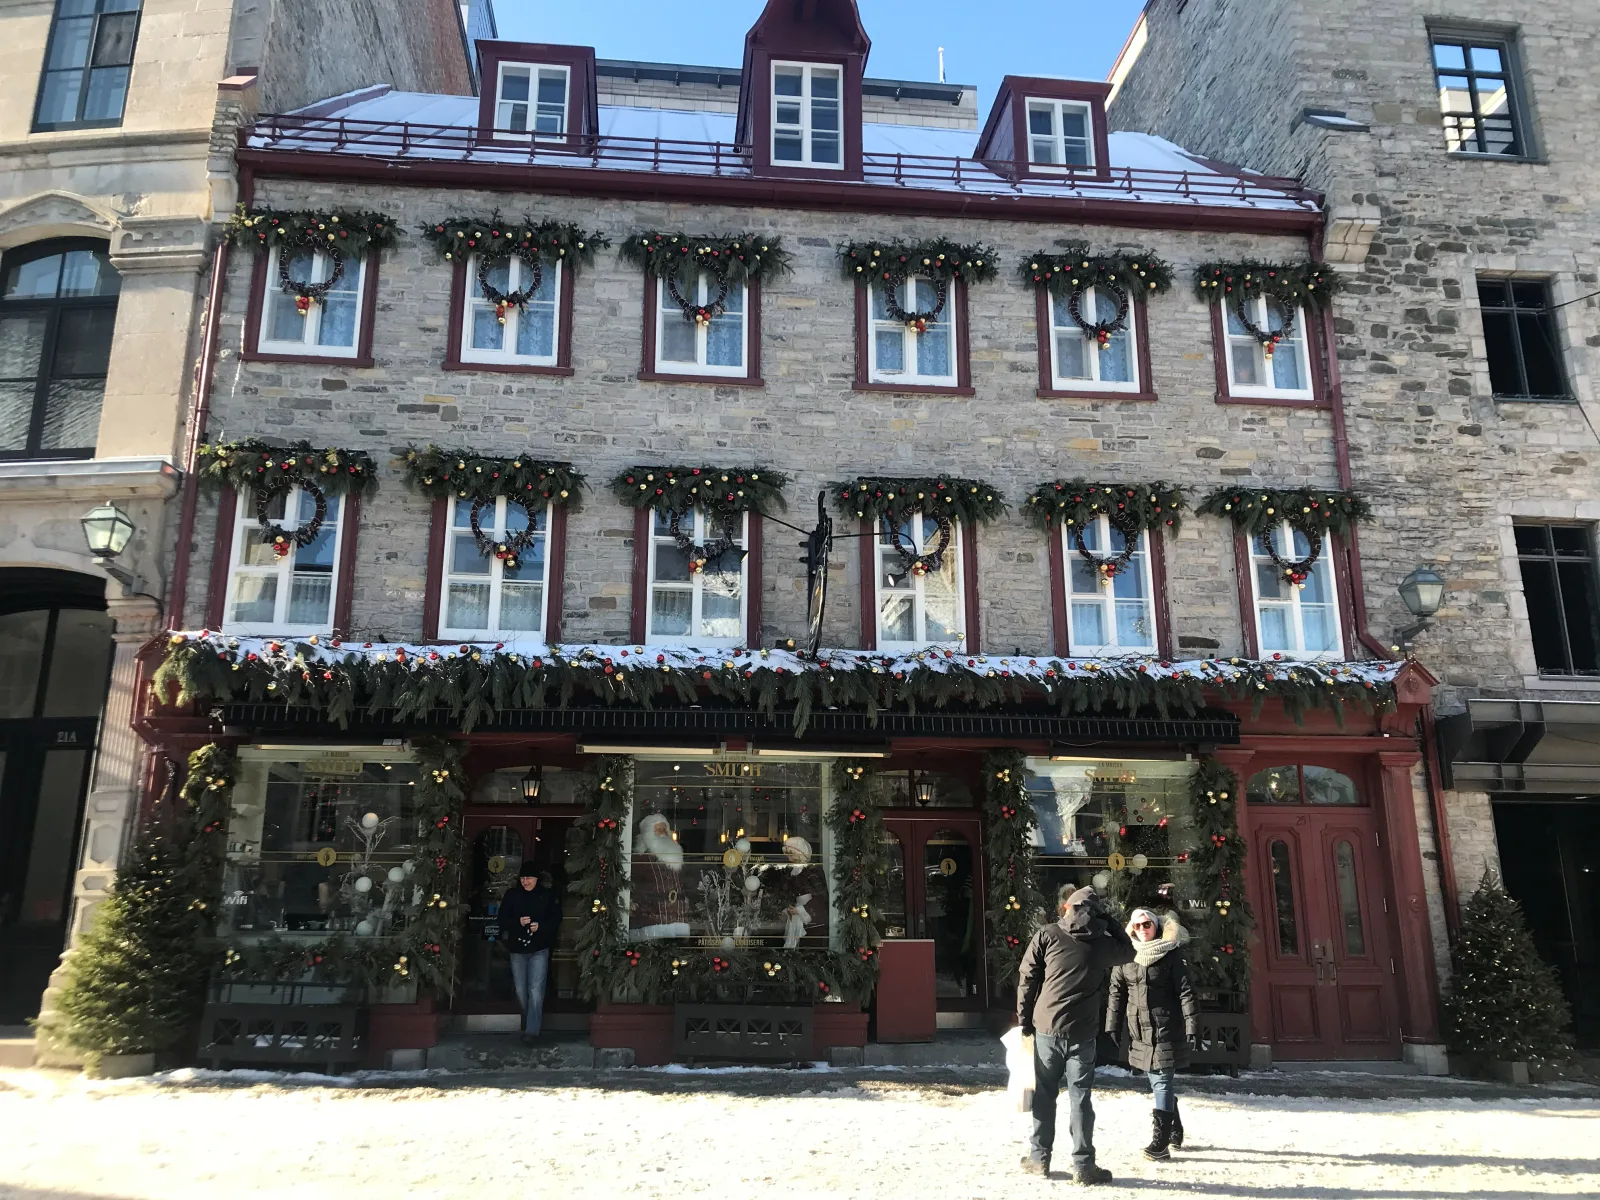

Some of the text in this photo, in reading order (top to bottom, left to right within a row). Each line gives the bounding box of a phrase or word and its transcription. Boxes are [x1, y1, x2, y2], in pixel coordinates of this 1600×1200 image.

[705, 763, 761, 776] SMITH
[1084, 769, 1137, 782] SMITH
[1296, 815, 1307, 827] 25
[224, 895, 248, 905] Wifi
